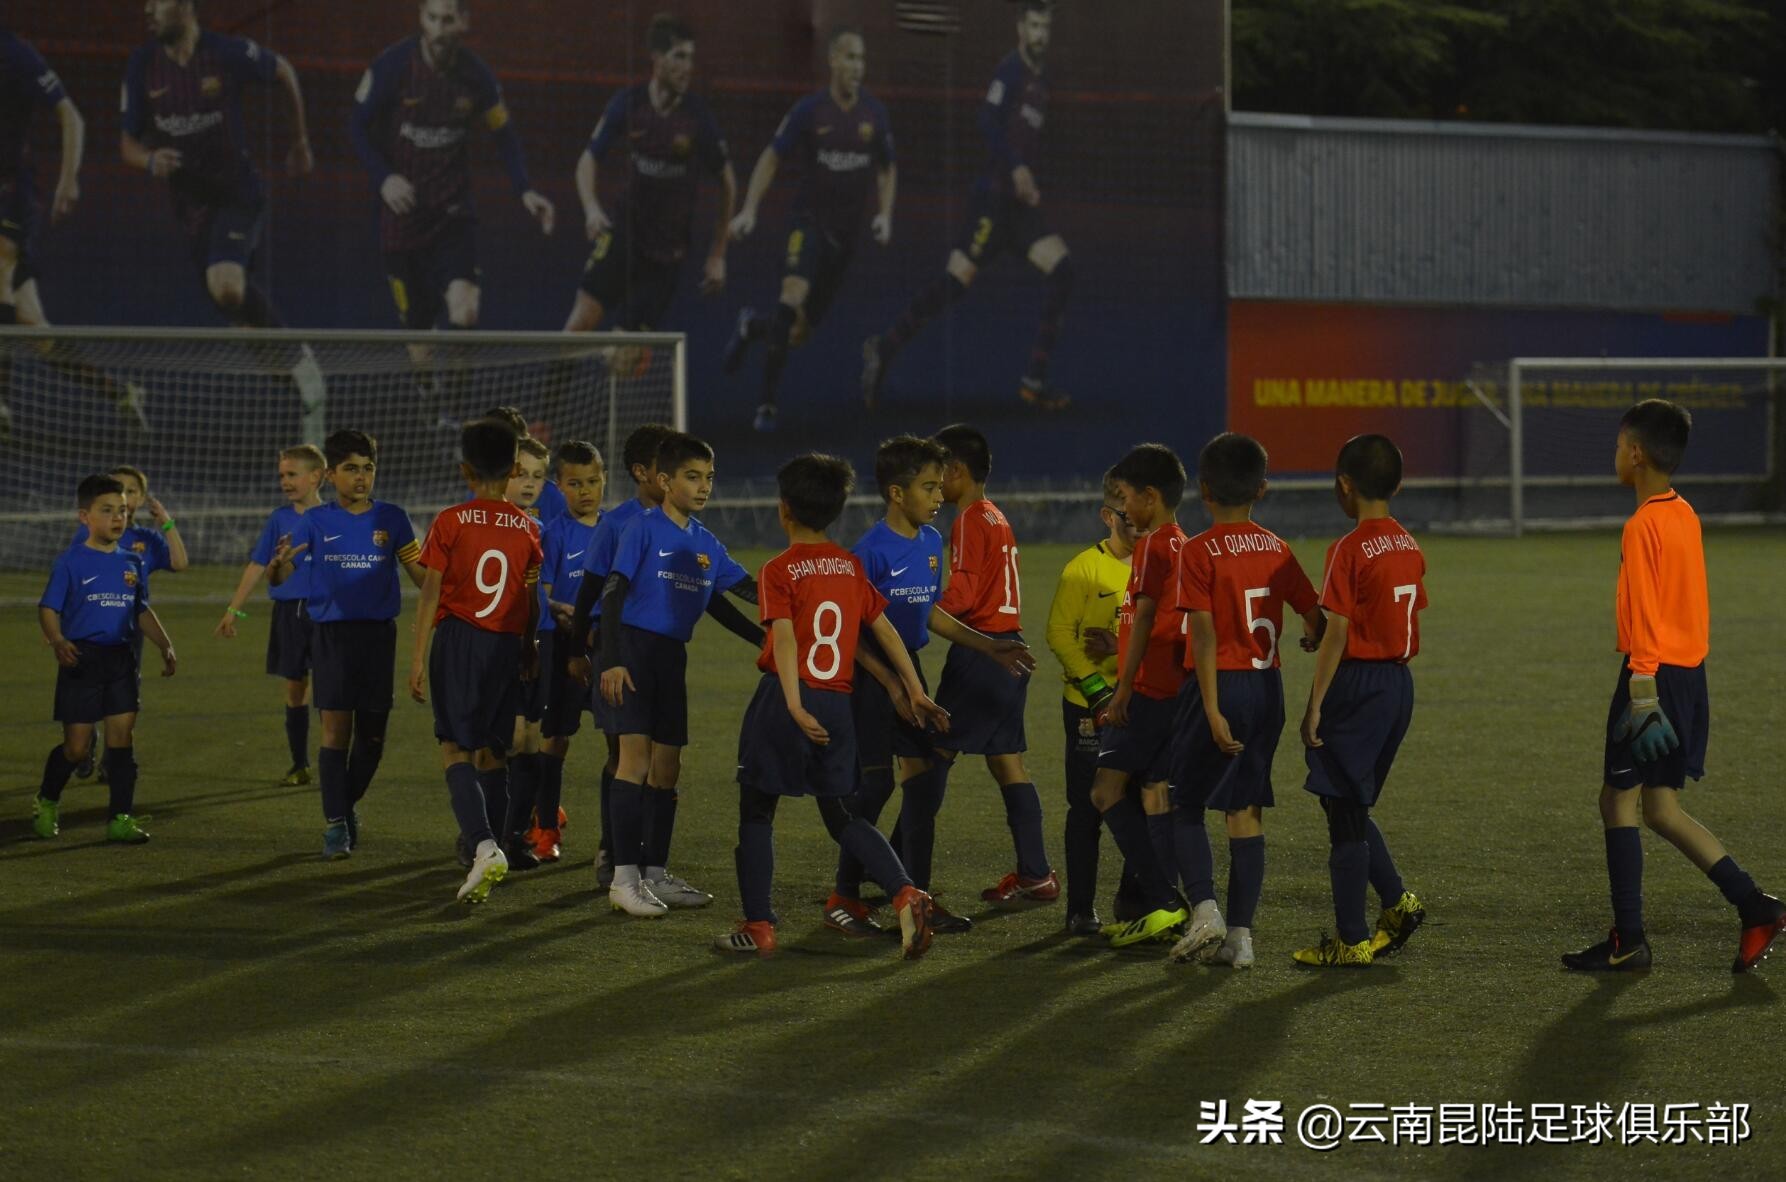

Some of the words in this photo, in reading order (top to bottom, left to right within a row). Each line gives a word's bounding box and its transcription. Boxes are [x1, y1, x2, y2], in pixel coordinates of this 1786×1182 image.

[1254, 378, 1300, 408] UNA
[1305, 378, 1397, 408] MANERA
[457, 508, 488, 525] WEI
[1204, 538, 1222, 556] LI
[1224, 533, 1282, 557] QIANDING
[1361, 535, 1395, 559] GUAN
[474, 549, 509, 618] 9
[788, 561, 817, 581] SHAN
[1244, 587, 1276, 670] 5
[1393, 584, 1417, 659] 7
[806, 600, 843, 680] 8
